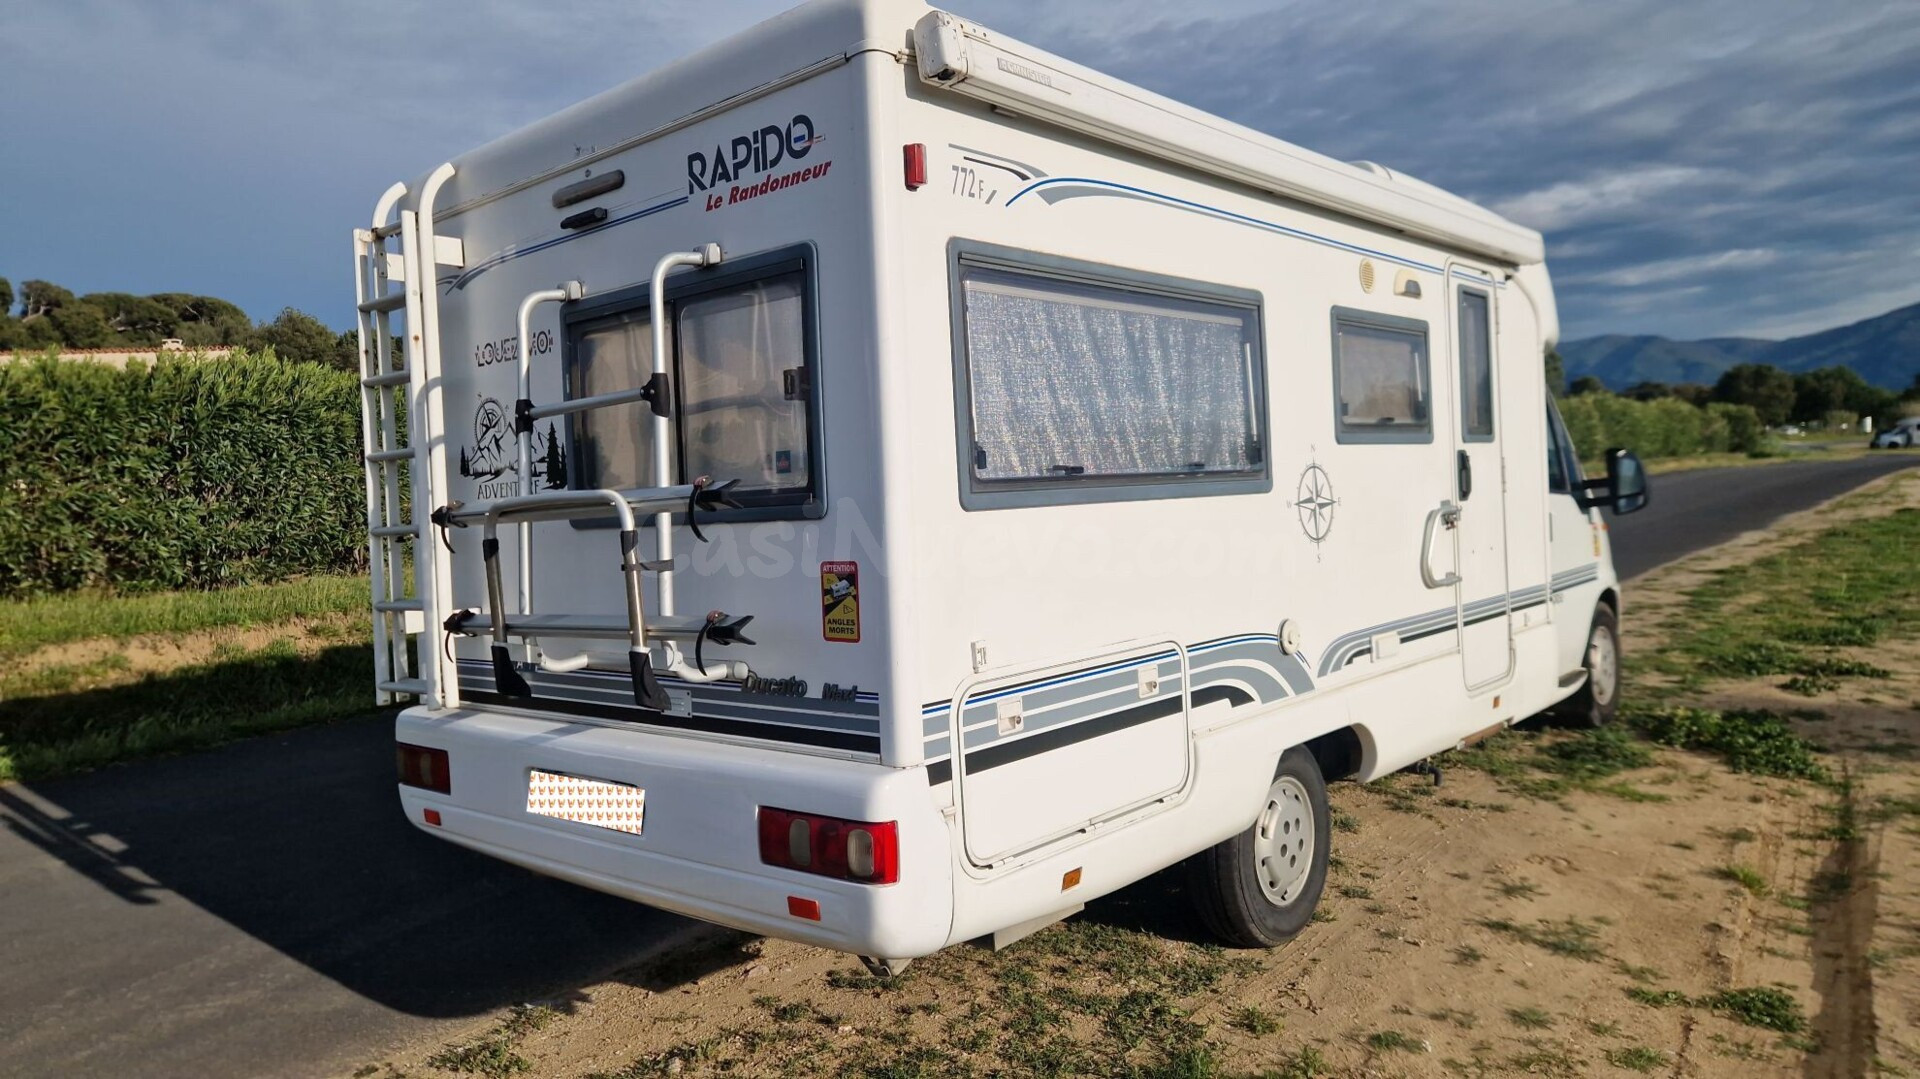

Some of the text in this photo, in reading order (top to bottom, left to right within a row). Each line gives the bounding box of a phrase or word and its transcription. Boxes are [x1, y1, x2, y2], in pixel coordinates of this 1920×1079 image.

[706, 160, 832, 212] Le Randonneur
[951, 164, 984, 200] 772 F
[477, 480, 540, 499] ADVENTE
[822, 564, 856, 572] ATTENTION
[827, 618, 856, 626] ANGLES
[828, 627, 855, 635] MORTS
[741, 670, 807, 697] Ducato
